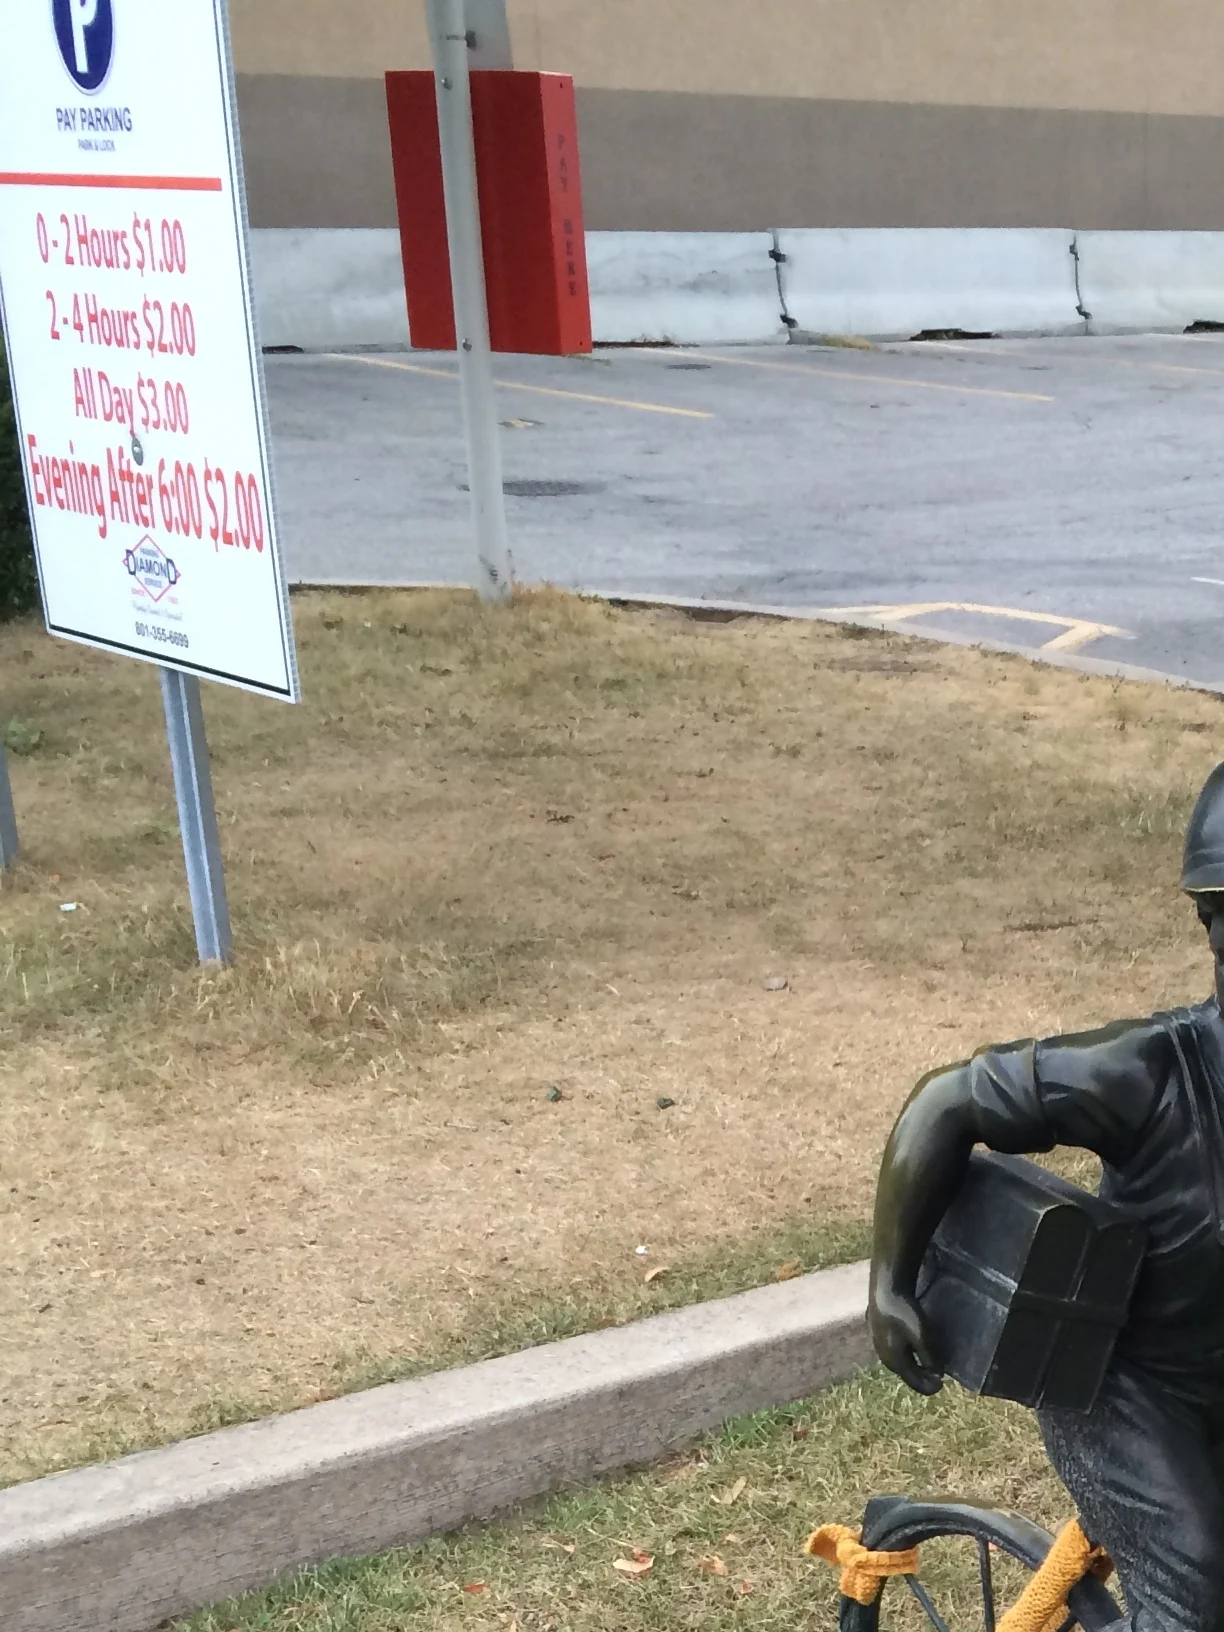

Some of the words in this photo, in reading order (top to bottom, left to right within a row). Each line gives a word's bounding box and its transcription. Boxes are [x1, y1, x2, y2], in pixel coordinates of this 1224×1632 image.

[56, 107, 77, 132] PAY
[80, 107, 132, 132] PARKING
[74, 213, 130, 270] Hours
[132, 211, 186, 277] $1.00
[84, 293, 140, 350] Hours
[142, 293, 196, 358] $2.00
[73, 367, 98, 419] All
[97, 371, 136, 440] Day
[137, 371, 189, 434] $3.00
[27, 434, 107, 539] Evening
[106, 446, 156, 529] After
[158, 458, 202, 540] 6:00
[204, 457, 264, 553] $2.00
[125, 549, 177, 585] DIAMOND
